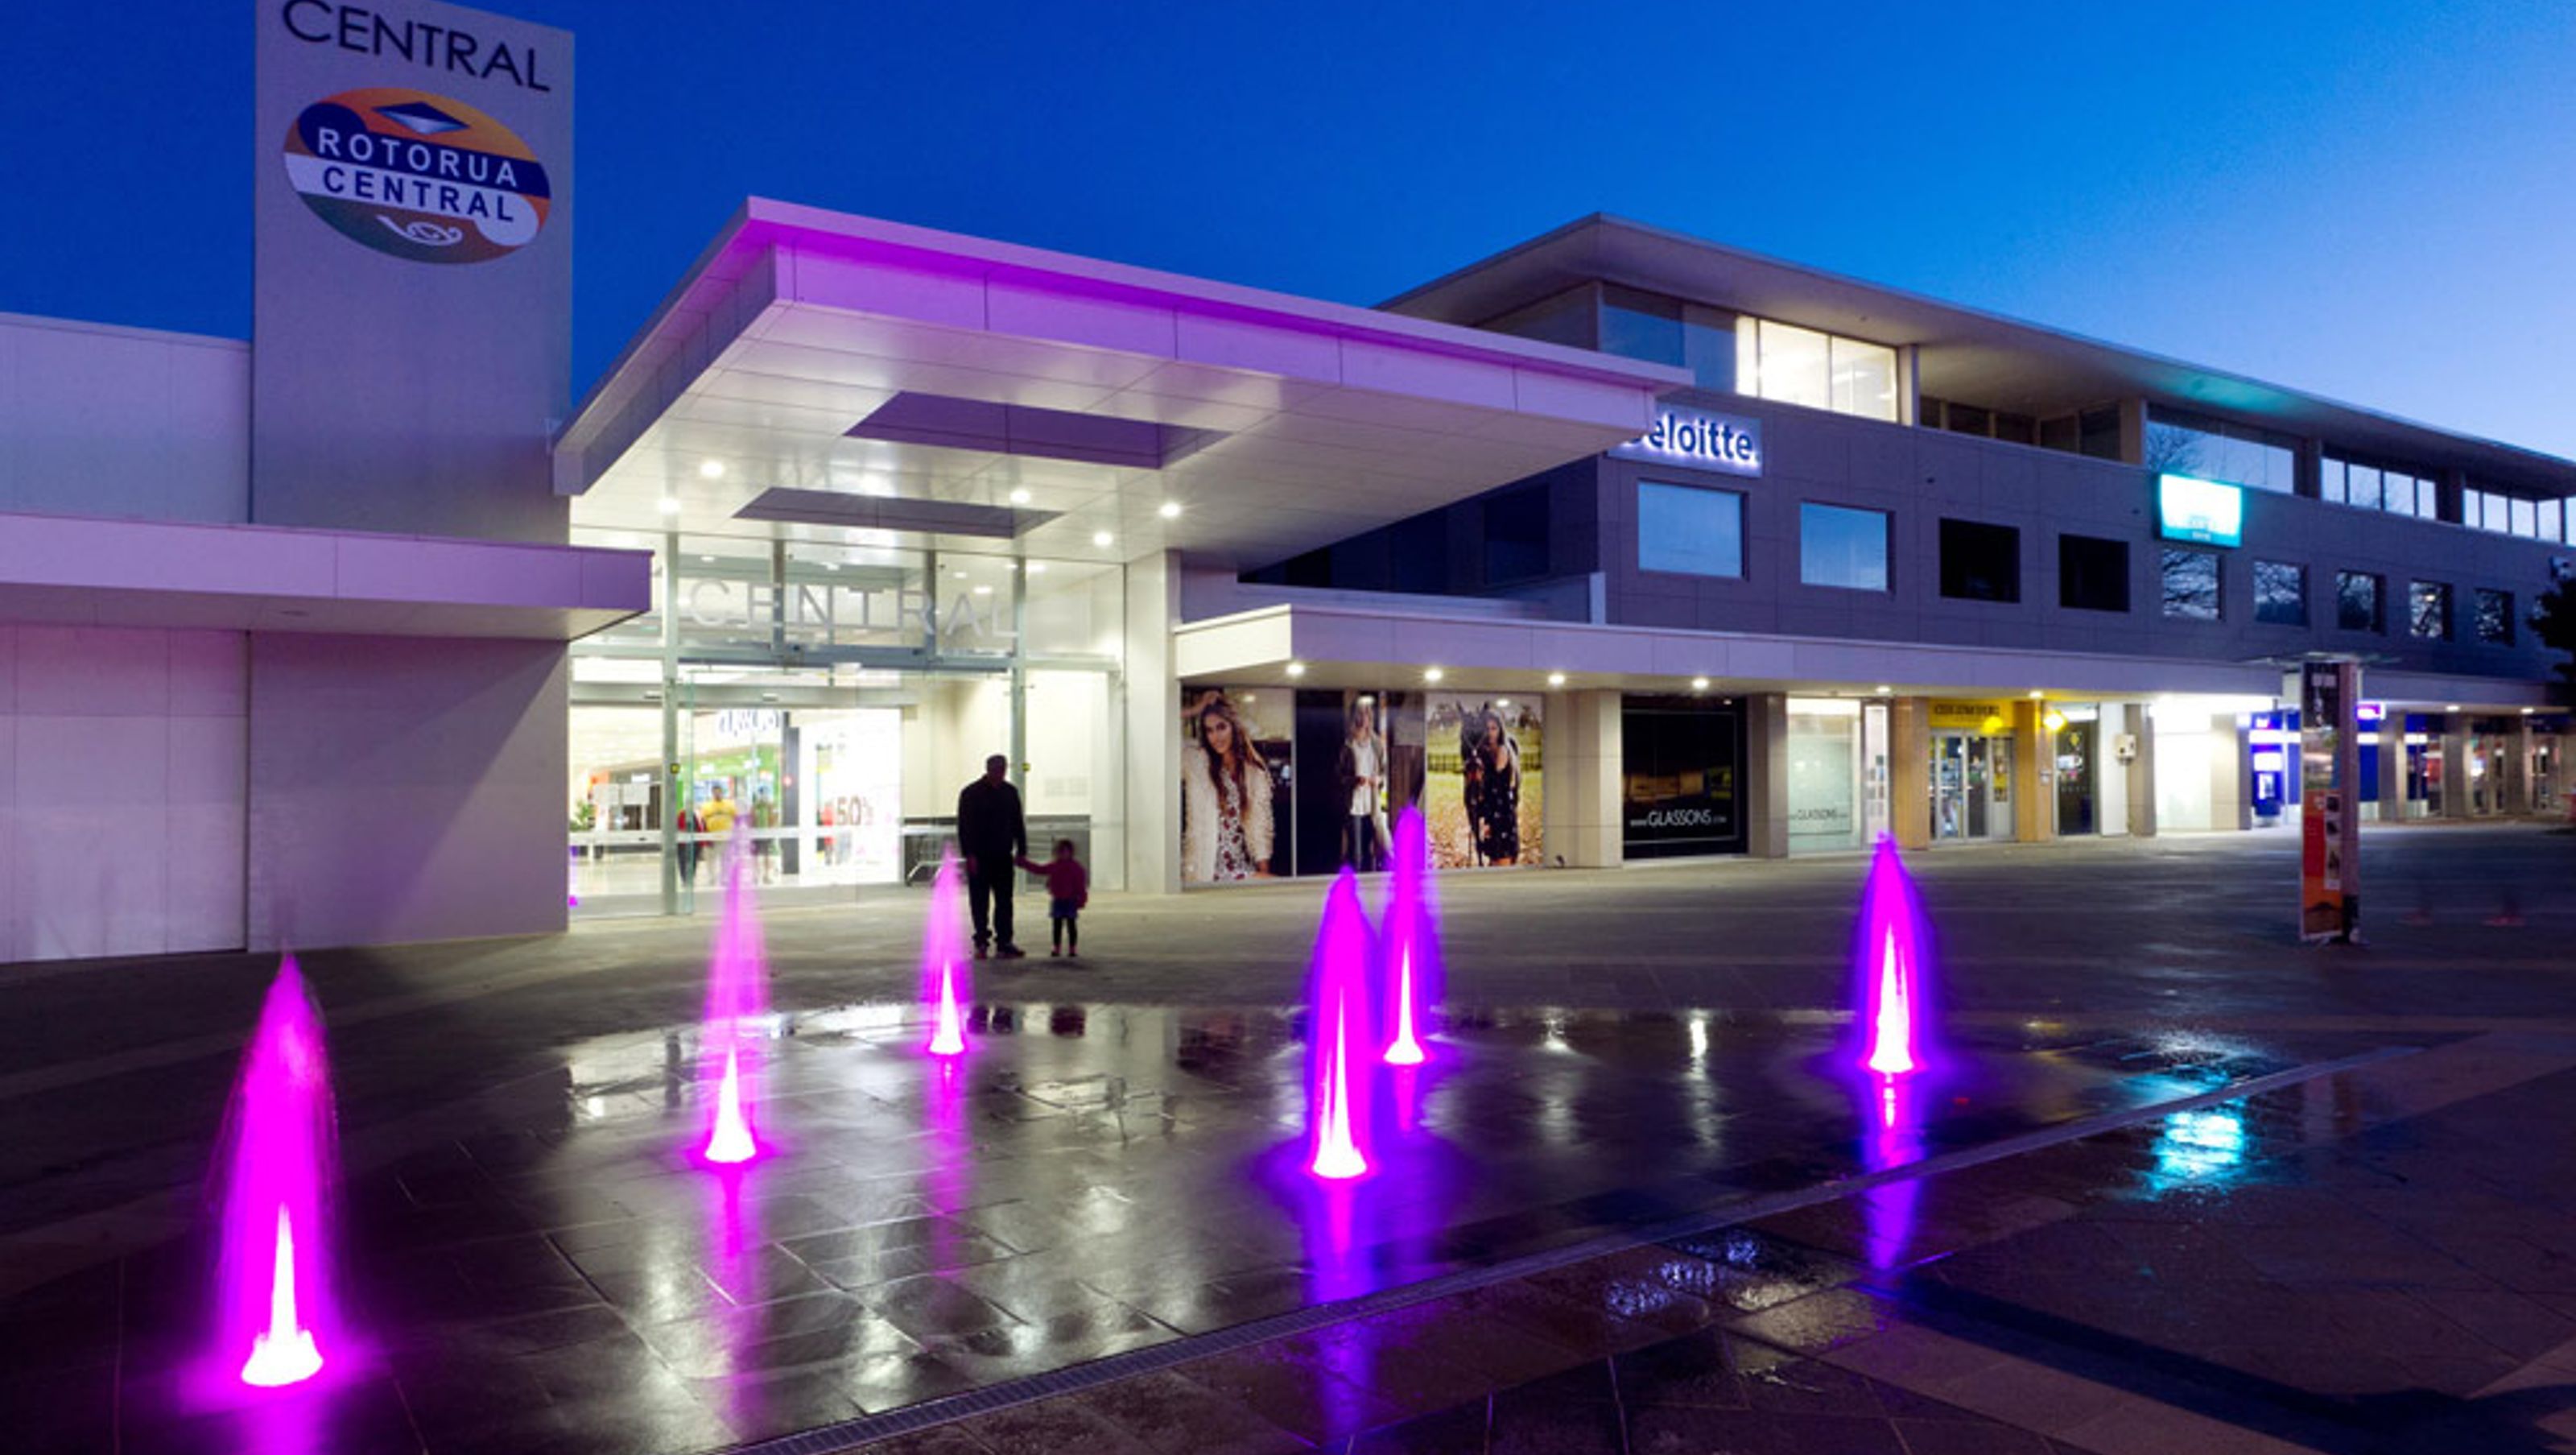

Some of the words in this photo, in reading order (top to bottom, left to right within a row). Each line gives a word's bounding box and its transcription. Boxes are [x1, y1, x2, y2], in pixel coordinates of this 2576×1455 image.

[283, 0, 551, 93] CENTRAL
[319, 127, 518, 188] ROTORUA
[324, 166, 514, 222] CENTRAL
[691, 578, 1019, 639] CENTRAL
